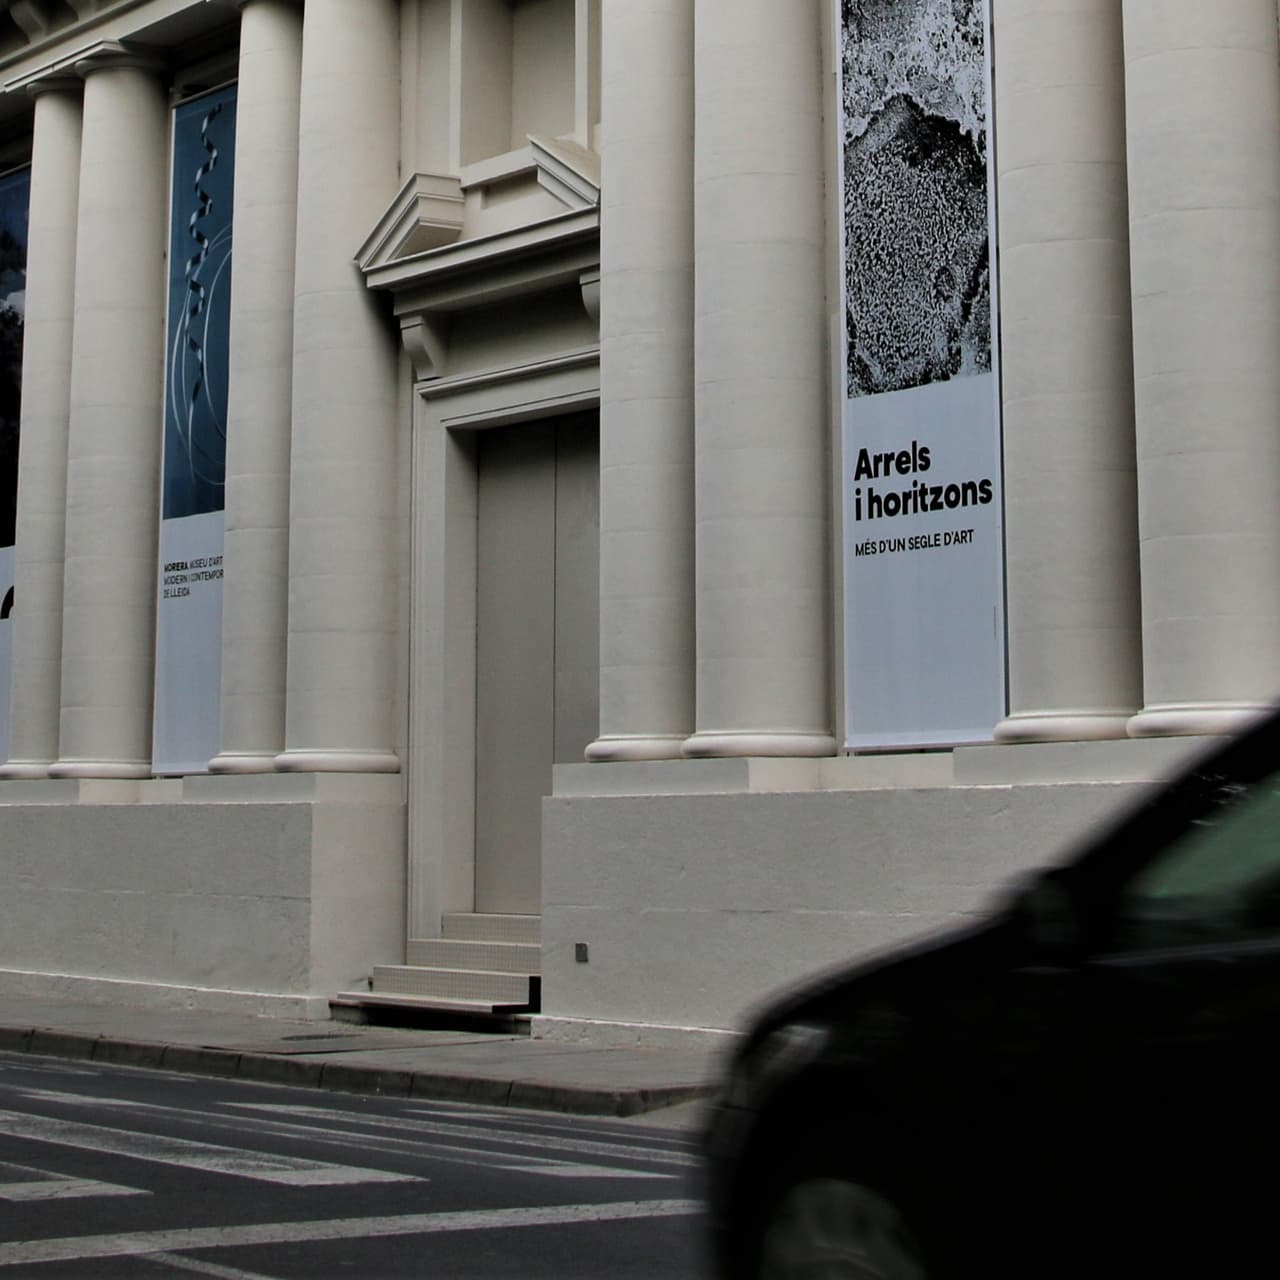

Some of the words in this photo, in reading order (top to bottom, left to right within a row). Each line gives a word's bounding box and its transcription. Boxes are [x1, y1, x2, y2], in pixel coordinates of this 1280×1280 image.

[854, 440, 931, 481] Arrels
[855, 487, 862, 521] i
[868, 479, 993, 519] horitzons
[855, 538, 877, 557] MÉS
[908, 533, 941, 551] SEGLE
[164, 561, 189, 573] MORERA
